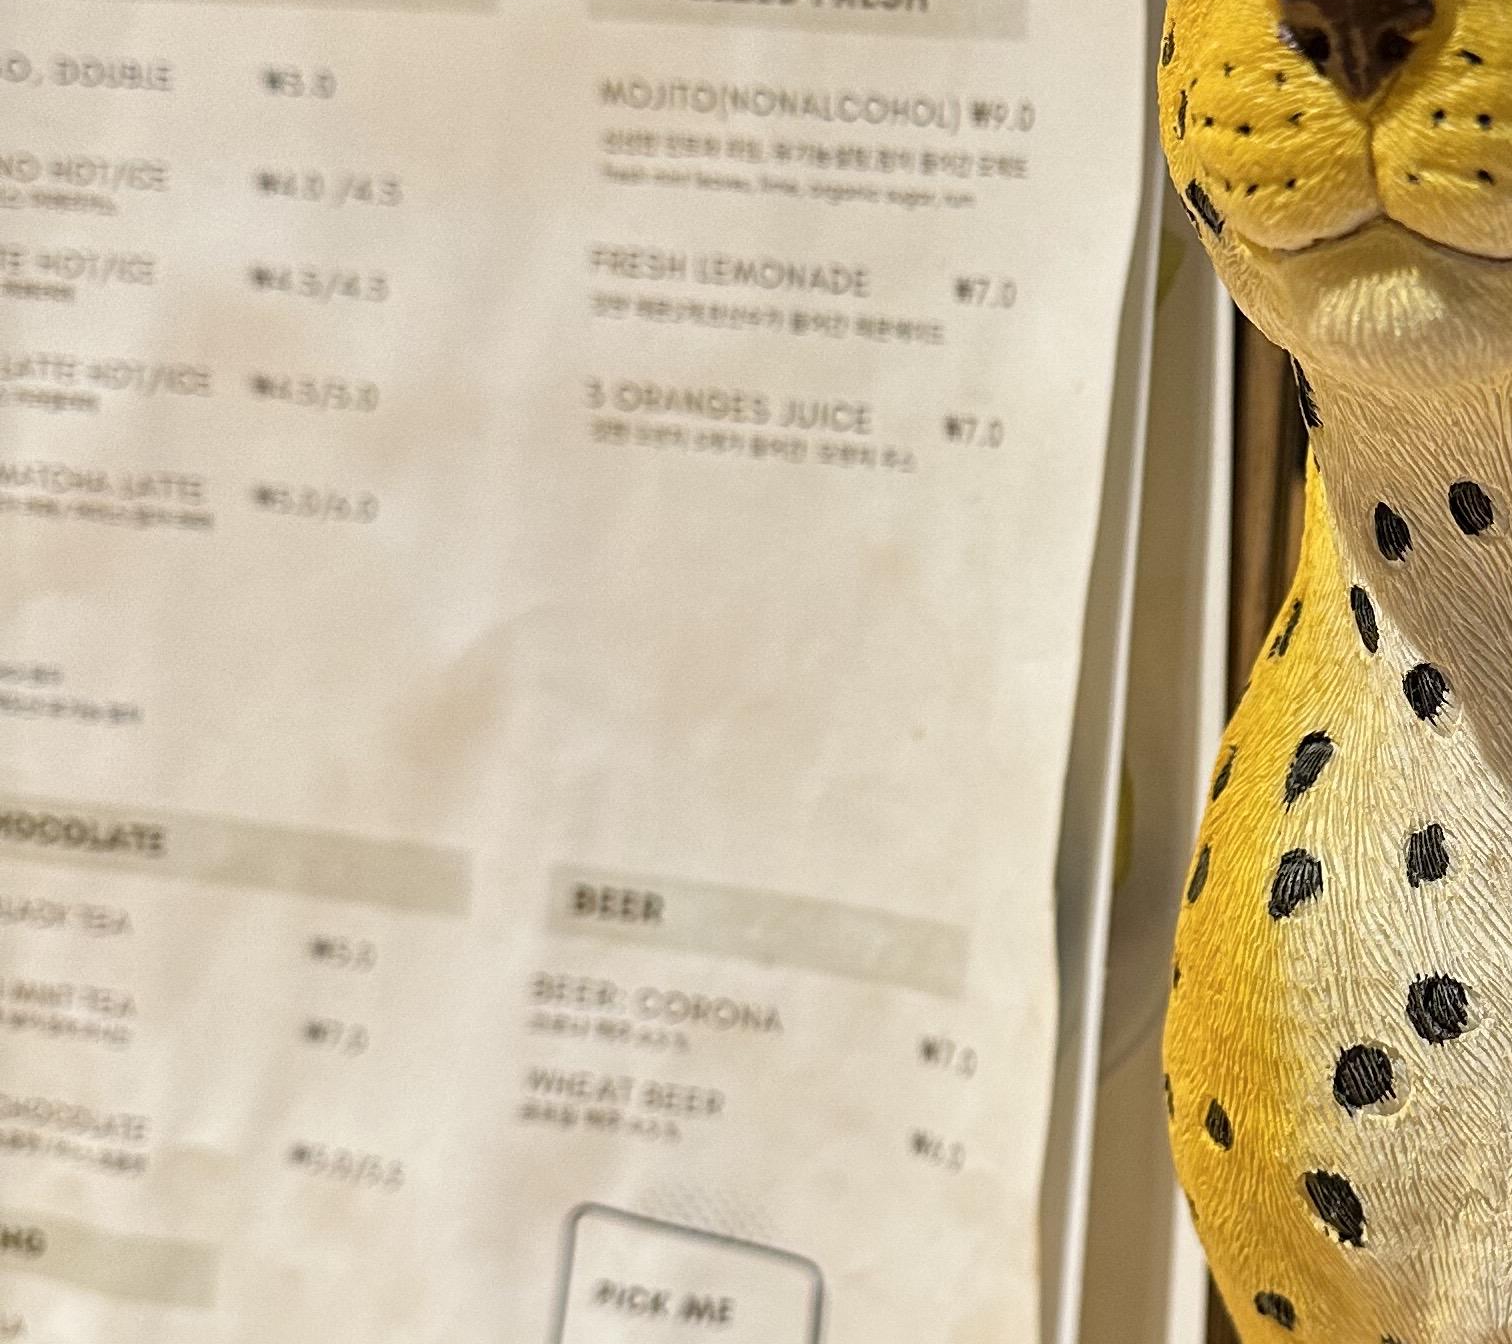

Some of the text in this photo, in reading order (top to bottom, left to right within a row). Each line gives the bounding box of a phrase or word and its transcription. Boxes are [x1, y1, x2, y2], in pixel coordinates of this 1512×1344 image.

[588, 242, 872, 299] FRESH LEMONADE
[782, 399, 873, 435] JUICE
[570, 879, 666, 926] BEER
[633, 986, 786, 1036] CORONA
[642, 1079, 727, 1118] BEER
[592, 1275, 738, 1328] PICK ME
